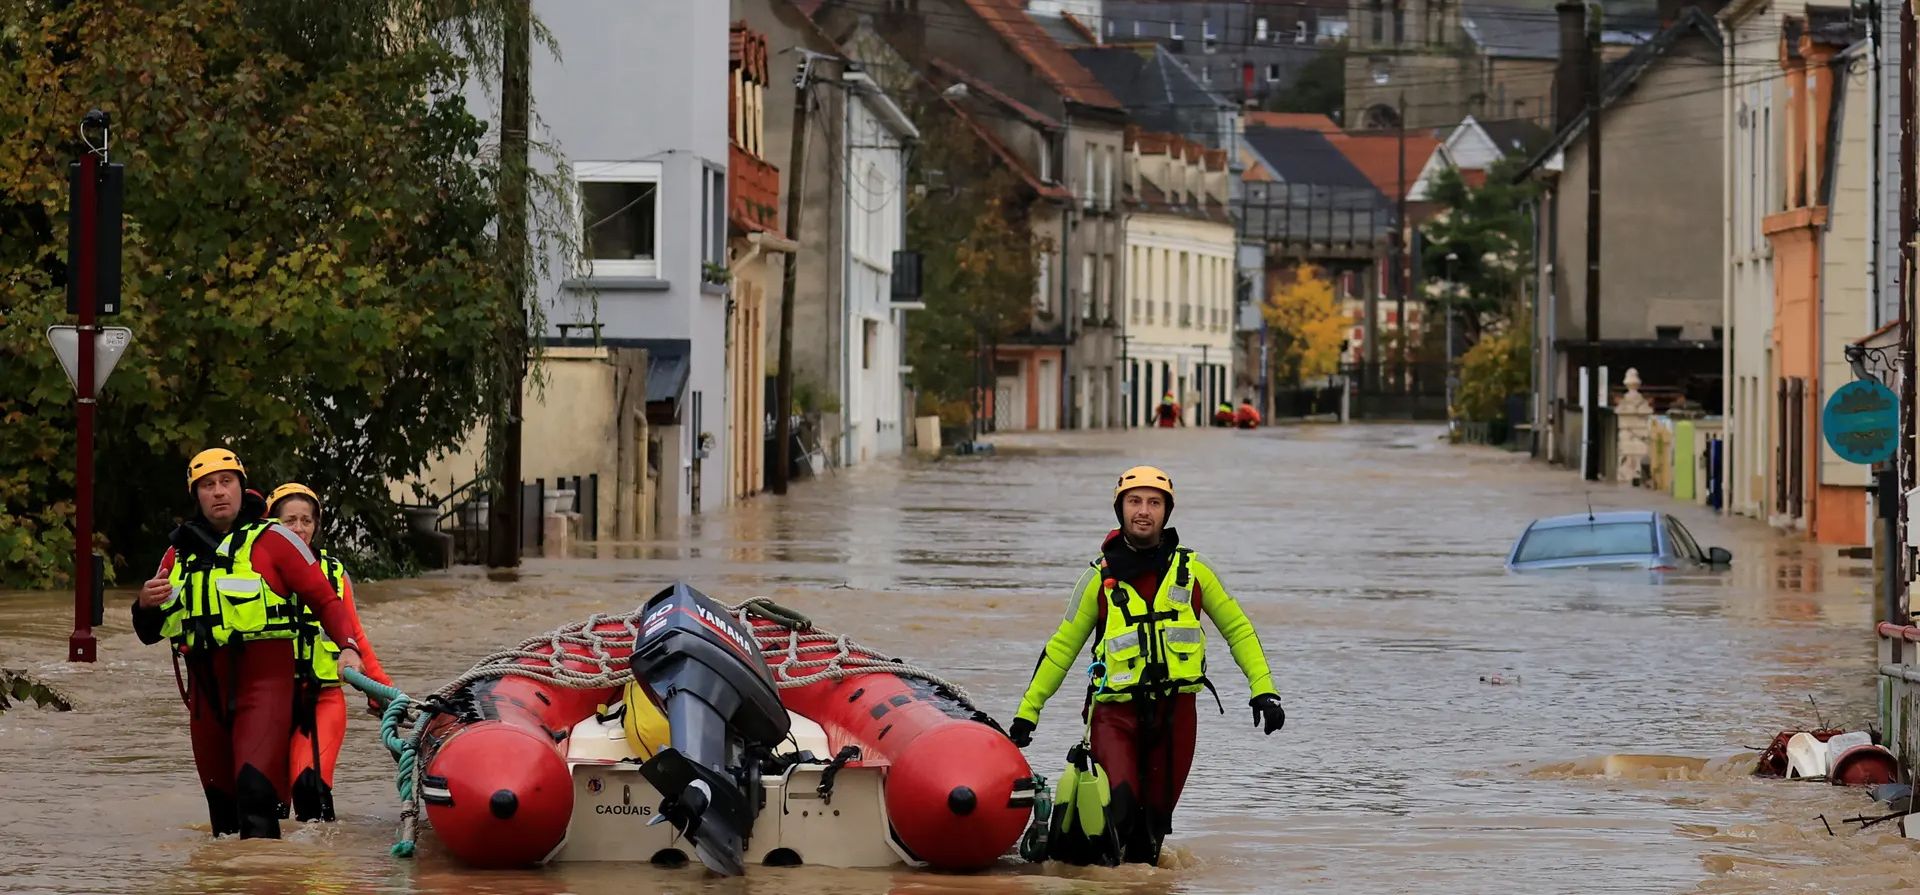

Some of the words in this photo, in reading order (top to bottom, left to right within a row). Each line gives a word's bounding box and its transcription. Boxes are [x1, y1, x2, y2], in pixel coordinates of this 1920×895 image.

[643, 603, 674, 626] 40
[695, 604, 753, 656] YAMAHA
[595, 804, 651, 816] CAOUAIS
